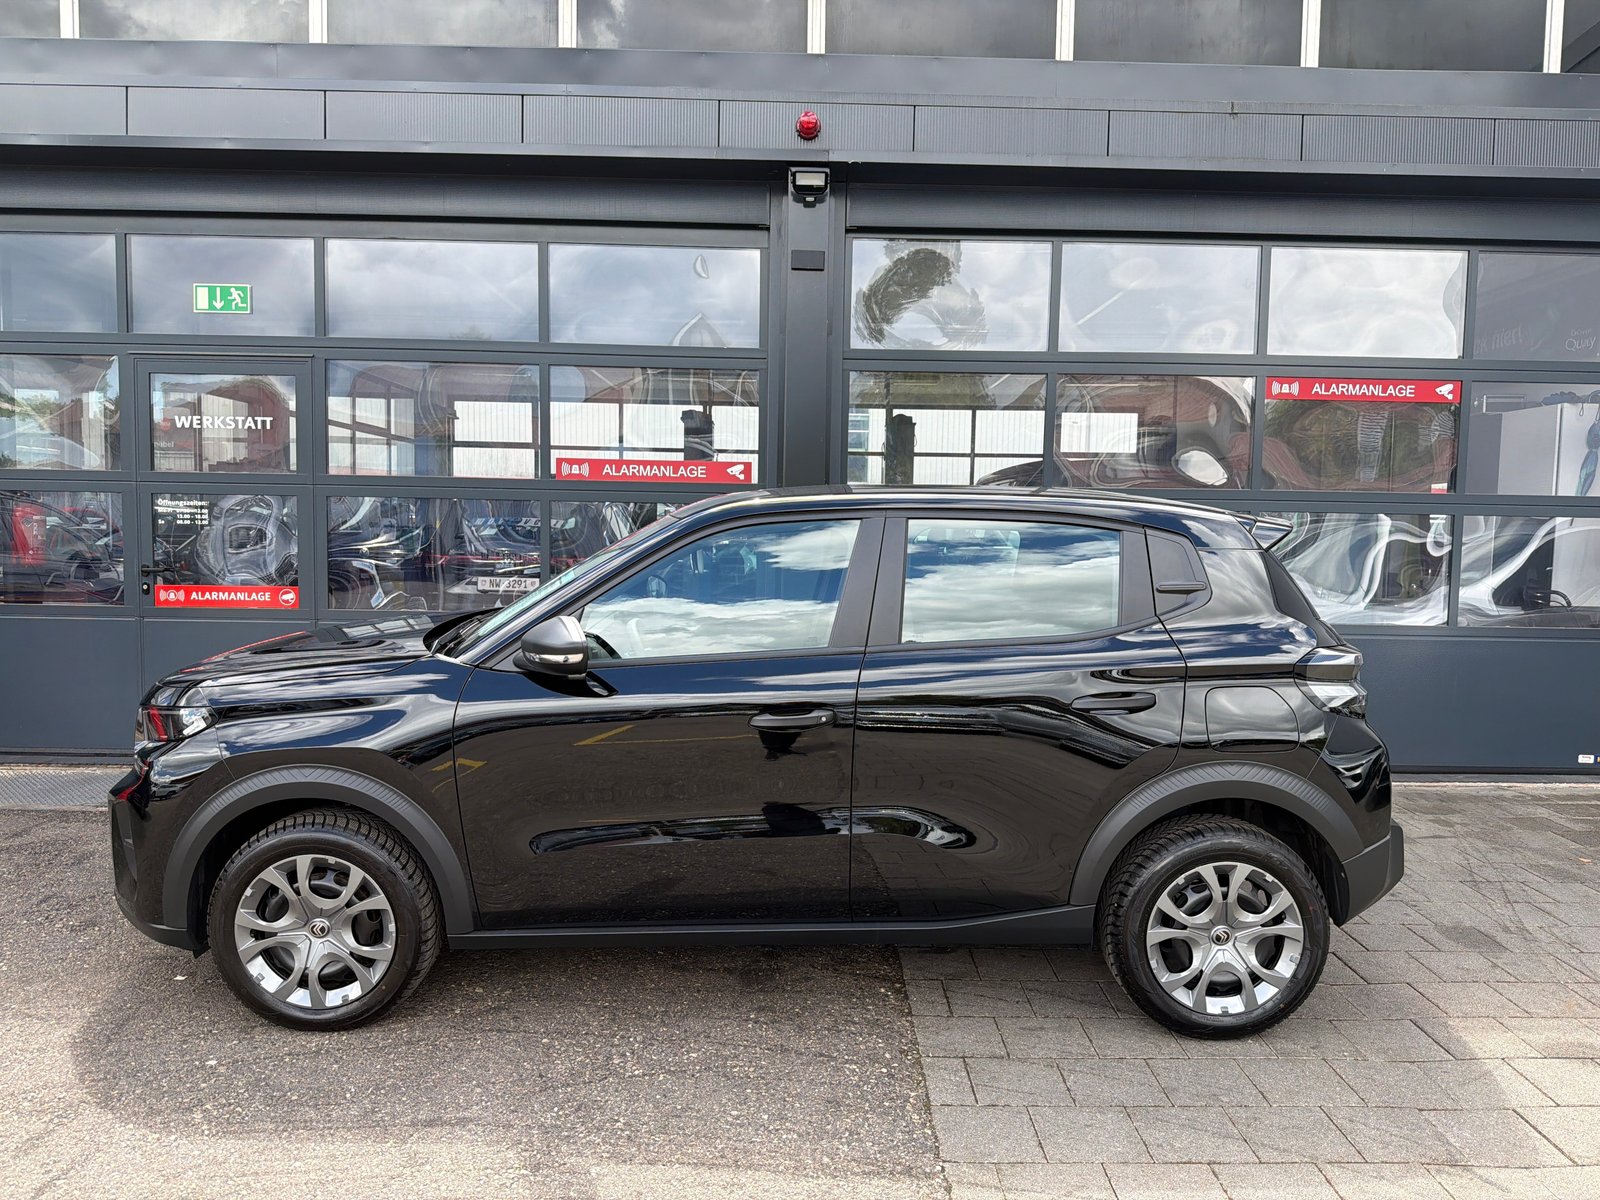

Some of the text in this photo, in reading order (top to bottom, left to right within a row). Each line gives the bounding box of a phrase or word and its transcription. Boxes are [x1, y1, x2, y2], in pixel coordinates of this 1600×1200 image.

[1311, 383, 1416, 398] ALARMANLAGE
[174, 415, 274, 430] WERKSTATT
[602, 464, 707, 478] ALARMANLAGE
[157, 498, 209, 507] Öffnungszeiten:
[190, 591, 271, 601] ALARMANLAGE
